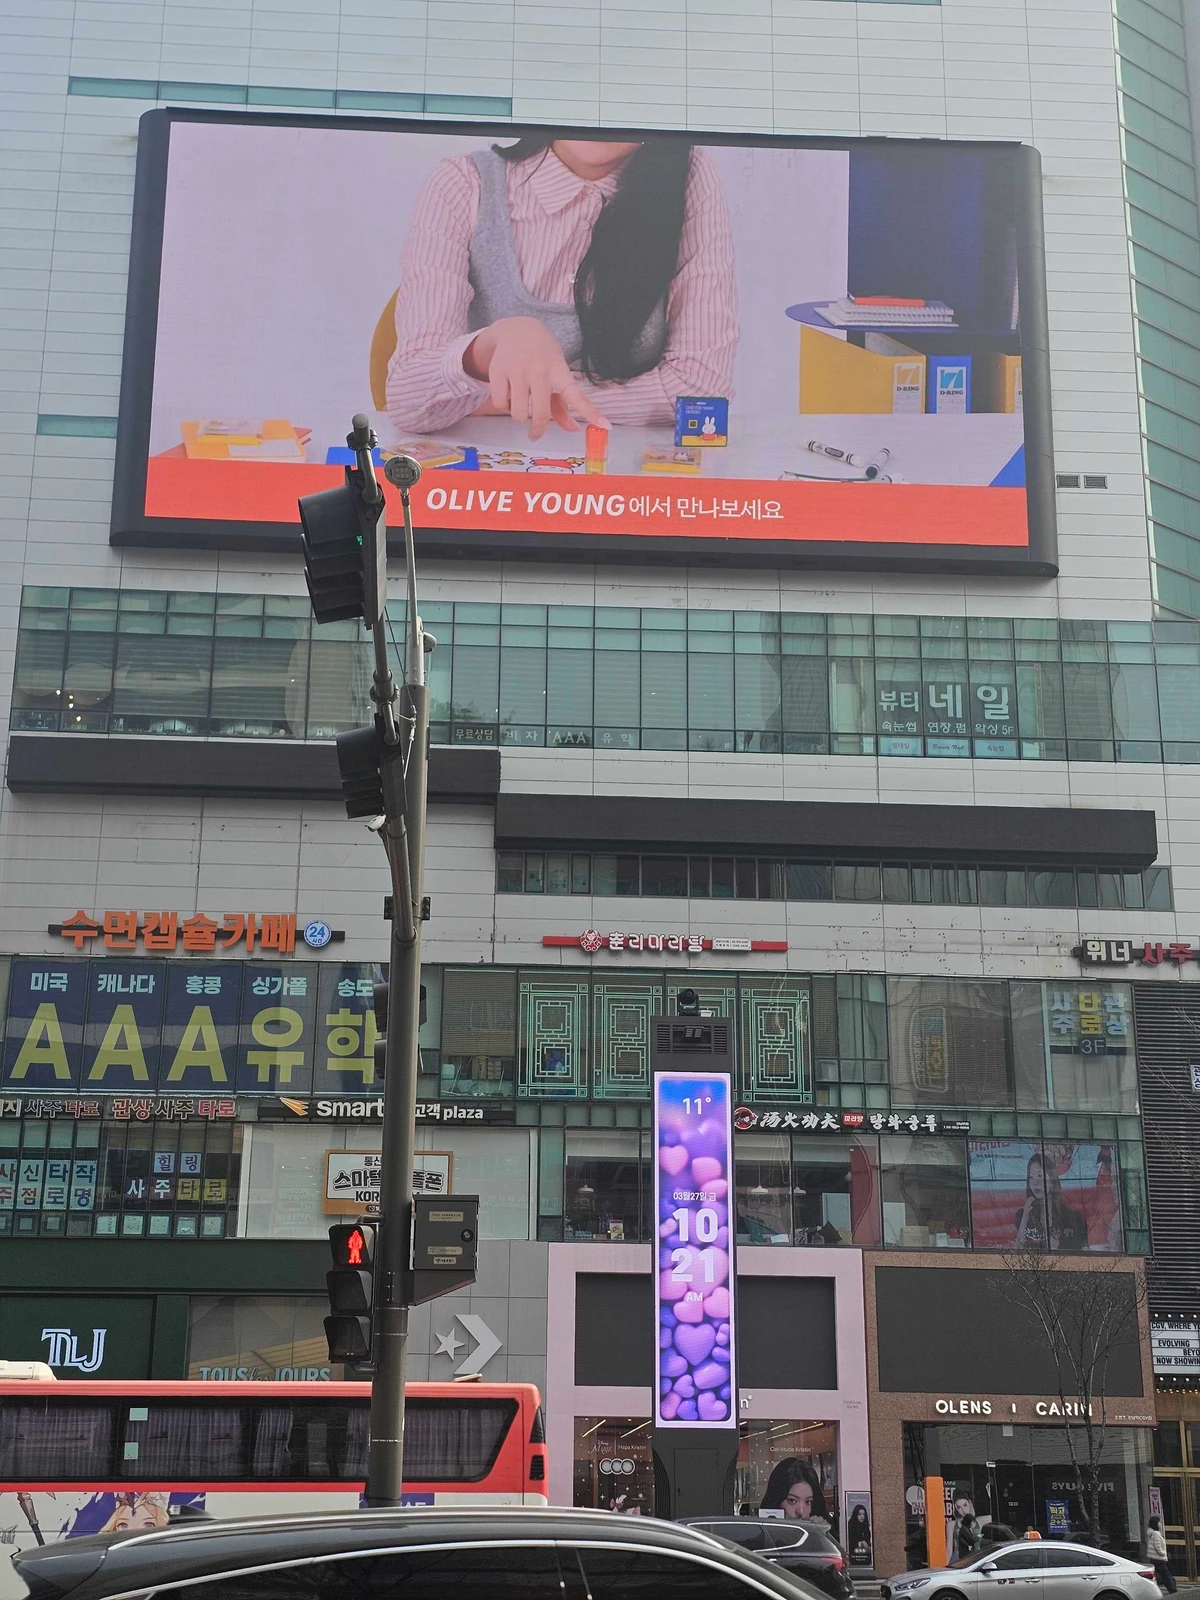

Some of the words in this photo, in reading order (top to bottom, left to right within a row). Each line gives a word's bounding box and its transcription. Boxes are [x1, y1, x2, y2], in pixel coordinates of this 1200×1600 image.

[426, 488, 514, 512] OLIVE
[677, 497, 785, 520] 만나보세요
[879, 690, 919, 712] 뷰티
[928, 684, 1010, 720] 네일
[456, 728, 494, 741] 무료상담
[552, 732, 587, 744] AAA
[600, 732, 633, 747] 유학
[1002, 725, 1014, 735] 5F
[61, 910, 296, 953] 수면캡슐카페
[309, 926, 326, 938] 24
[608, 931, 706, 953] 춘리마라탕
[1086, 940, 1130, 962] 위너
[1142, 942, 1194, 964] 사주
[30, 972, 69, 992] 미국
[98, 974, 155, 995] 캐나다
[186, 975, 222, 995] 홍콩
[252, 976, 308, 997] 싱가폴
[1081, 1040, 1106, 1054] 3F
[24, 1099, 63, 1119] 사주
[65, 1100, 101, 1119] 타로
[112, 1098, 153, 1120] 관상
[155, 1100, 195, 1120] 사주
[198, 1100, 237, 1120] 타로
[443, 1104, 484, 1121] plaza
[844, 1115, 864, 1123] 마라탕
[157, 1154, 198, 1172] 힐링
[127, 1178, 171, 1200] 사주
[180, 1180, 223, 1200] 타로
[673, 1192, 707, 1202] 03월27일
[708, 1192, 717, 1202] 금
[672, 1207, 719, 1243] 10
[671, 1247, 716, 1283] 21
[686, 1291, 704, 1302] AM
[1168, 1322, 1192, 1330] WHERE
[40, 1328, 108, 1373] TLJ
[1158, 1339, 1191, 1348] EVOLVING
[199, 1367, 248, 1381] TOUS
[935, 1400, 992, 1415] OLENS
